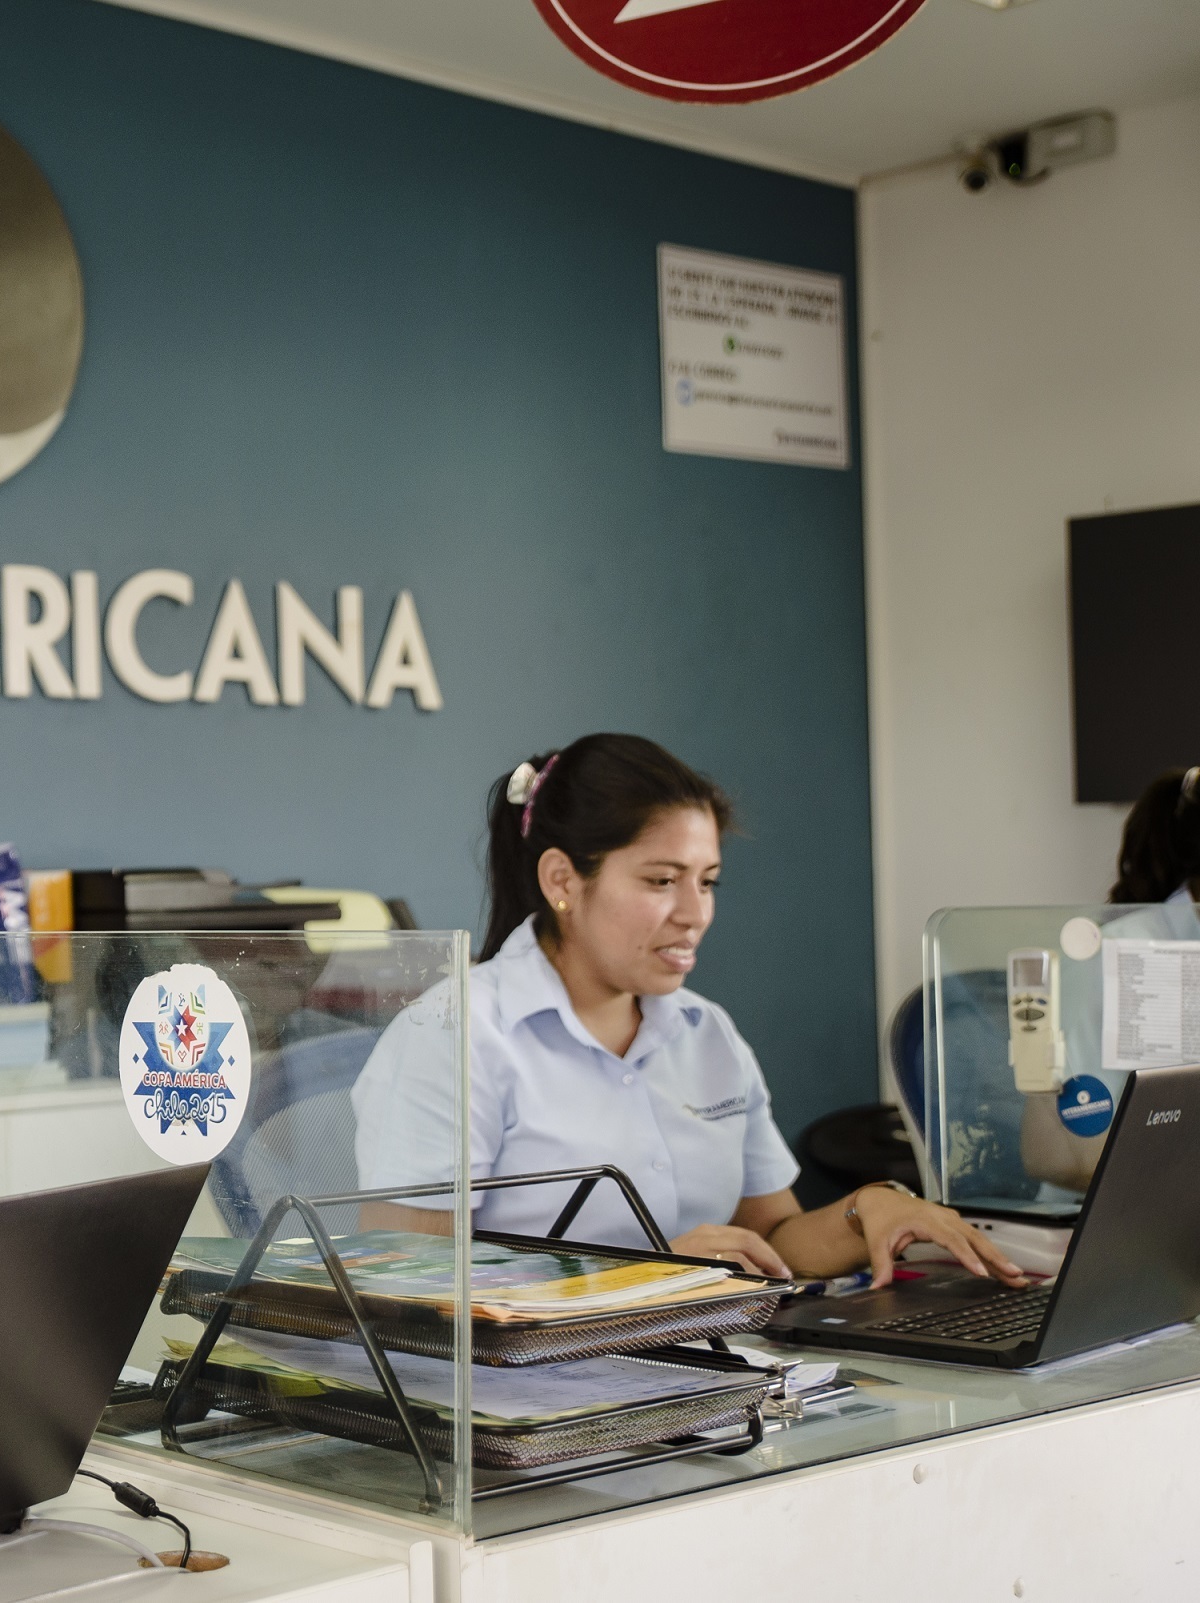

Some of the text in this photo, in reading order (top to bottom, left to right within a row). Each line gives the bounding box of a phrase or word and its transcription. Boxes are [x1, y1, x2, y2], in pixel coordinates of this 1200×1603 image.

[142, 1068, 228, 1089] COPA AMÉRICA
[189, 1091, 228, 1124] 2015
[1145, 1108, 1182, 1127] Lenovo
